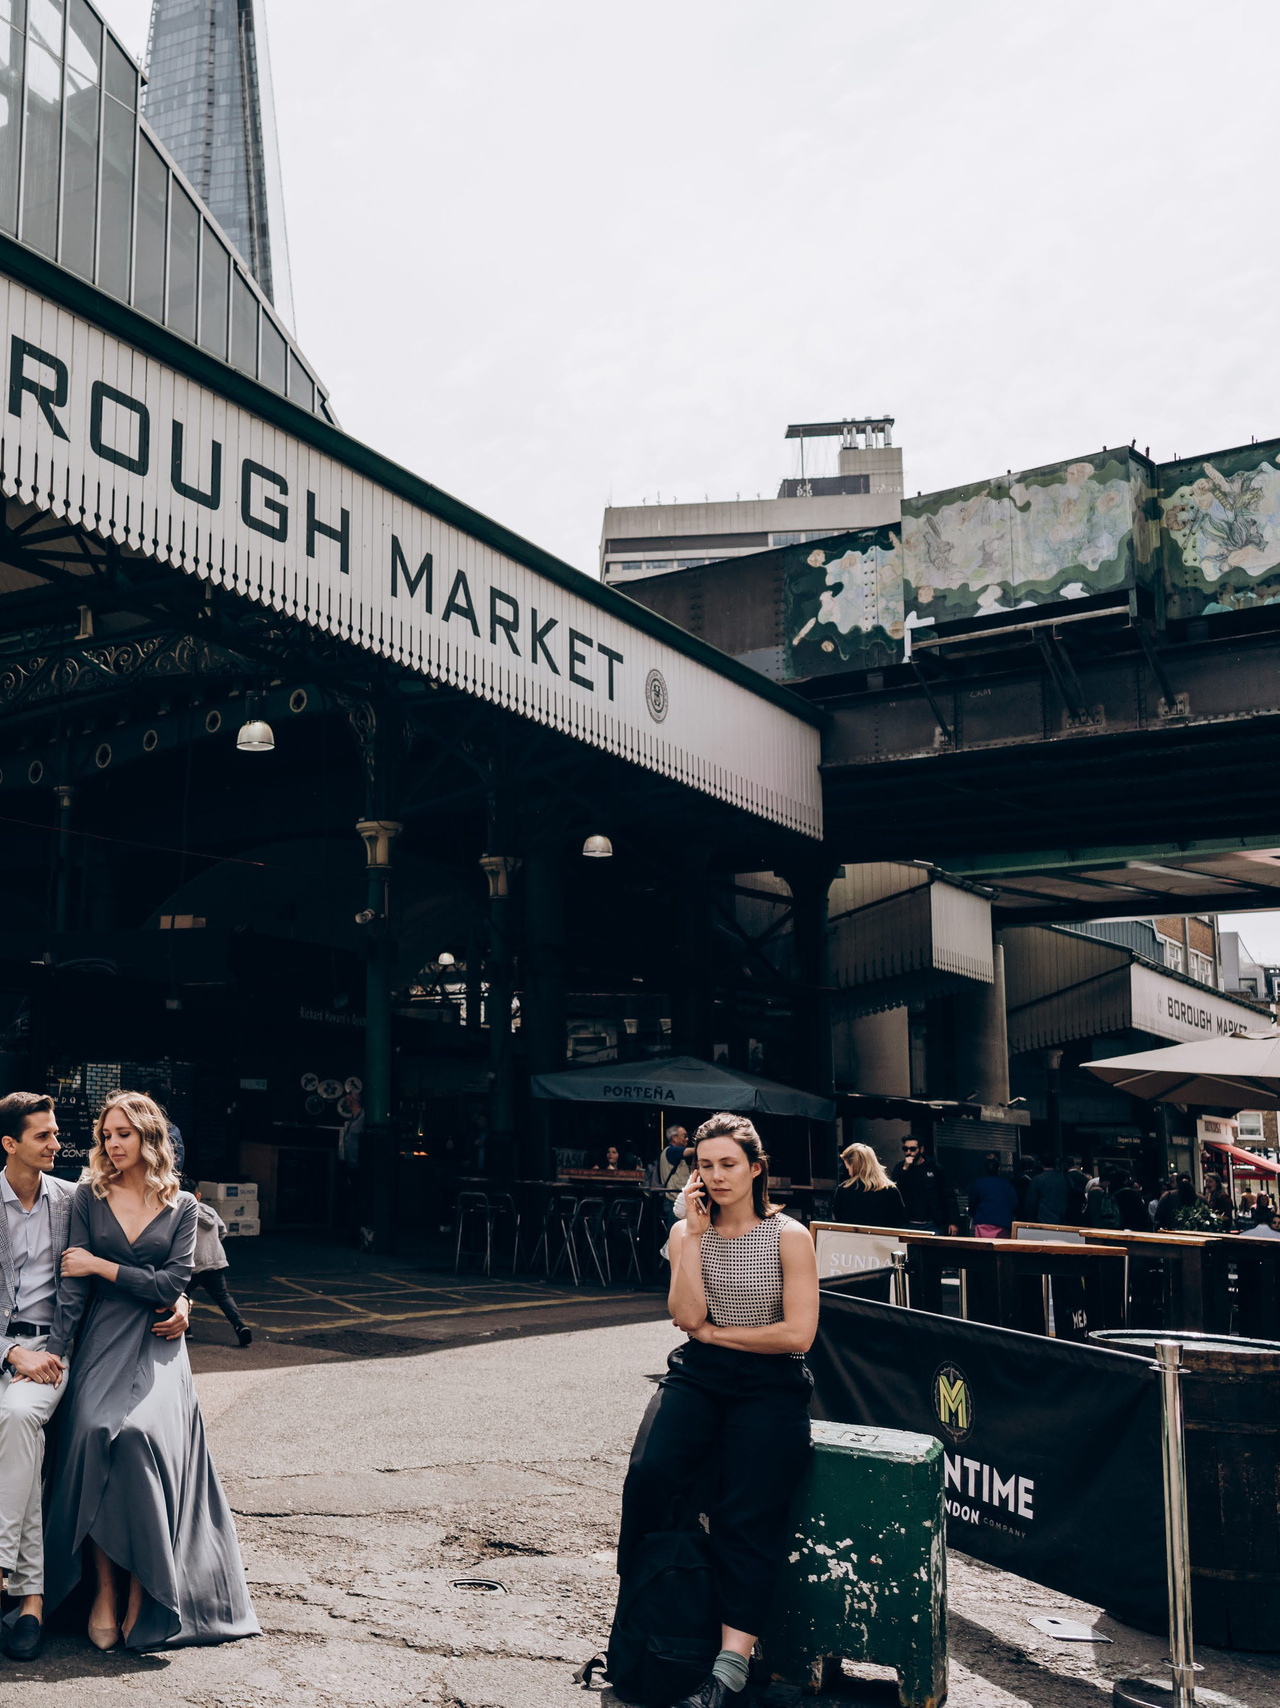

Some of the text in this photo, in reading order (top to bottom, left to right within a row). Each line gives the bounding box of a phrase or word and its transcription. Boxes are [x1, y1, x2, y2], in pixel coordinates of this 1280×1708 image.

[391, 535, 624, 701] MARKET
[1167, 996, 1212, 1032] BOROUGH
[603, 1086, 676, 1101] PORTEÑA
[944, 1450, 1035, 1520] NTIME
[945, 1498, 1026, 1539] NDON COMPANY
